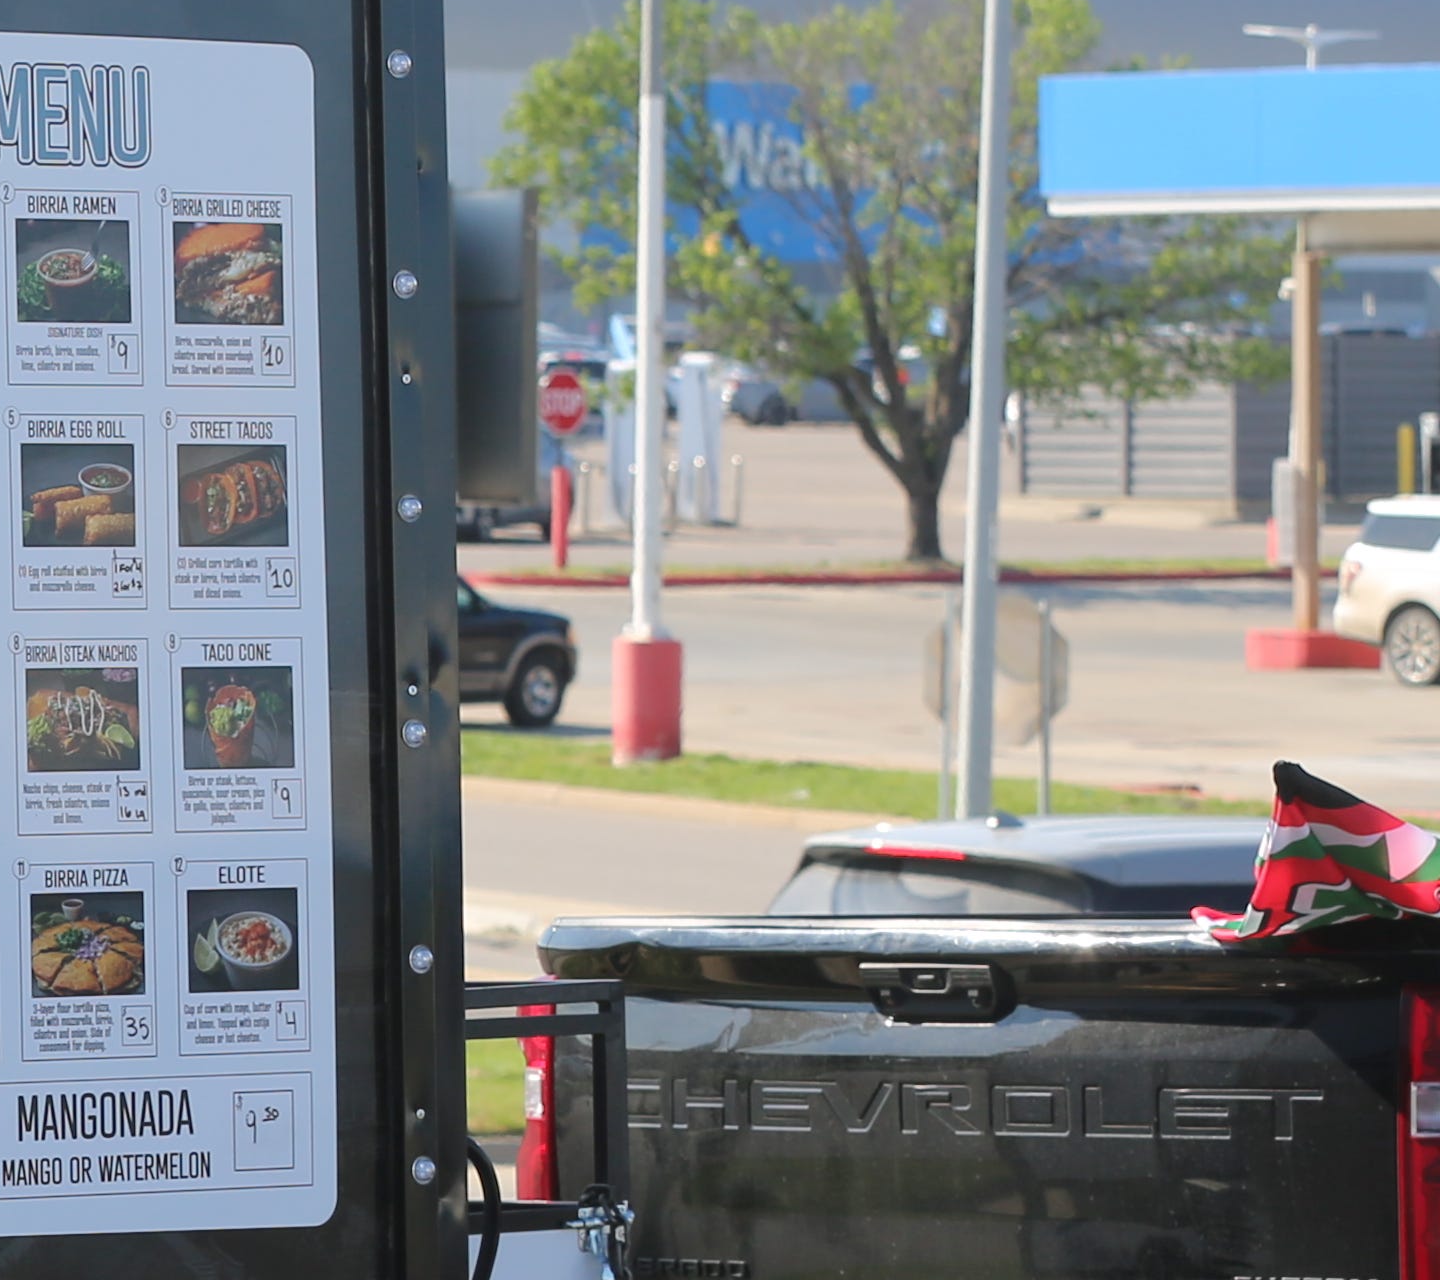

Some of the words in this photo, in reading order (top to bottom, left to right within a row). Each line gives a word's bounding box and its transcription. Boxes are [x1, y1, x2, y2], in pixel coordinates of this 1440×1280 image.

[3, 185, 9, 200] 2
[161, 188, 167, 203] 3
[28, 196, 68, 213] BIRRIA
[73, 197, 116, 214] RAMEN
[173, 199, 203, 216] BIRRIA
[207, 200, 243, 217] GRILLED
[247, 201, 281, 218] CHEESE
[8, 410, 15, 424] 5
[166, 411, 171, 426] 6
[28, 421, 66, 438] BIRRIA
[70, 422, 93, 438] EGG
[97, 422, 125, 438] ROLL
[190, 421, 232, 439] STREET
[237, 422, 273, 439] TACOS
[14, 635, 19, 650] 8
[170, 634, 175, 649] 9
[98, 645, 137, 661] NACHOS
[202, 644, 233, 661] TACO
[239, 643, 272, 661] CONE
[174, 857, 183, 872] 12
[45, 870, 88, 888] BIRRIA
[93, 869, 128, 887] PIZZA
[219, 865, 265, 884] ELOTE
[17, 1089, 194, 1142] MANGONADA
[2, 1157, 62, 1187] MANGO
[70, 1156, 92, 1183] OR
[98, 1151, 211, 1182] WATERMELON
